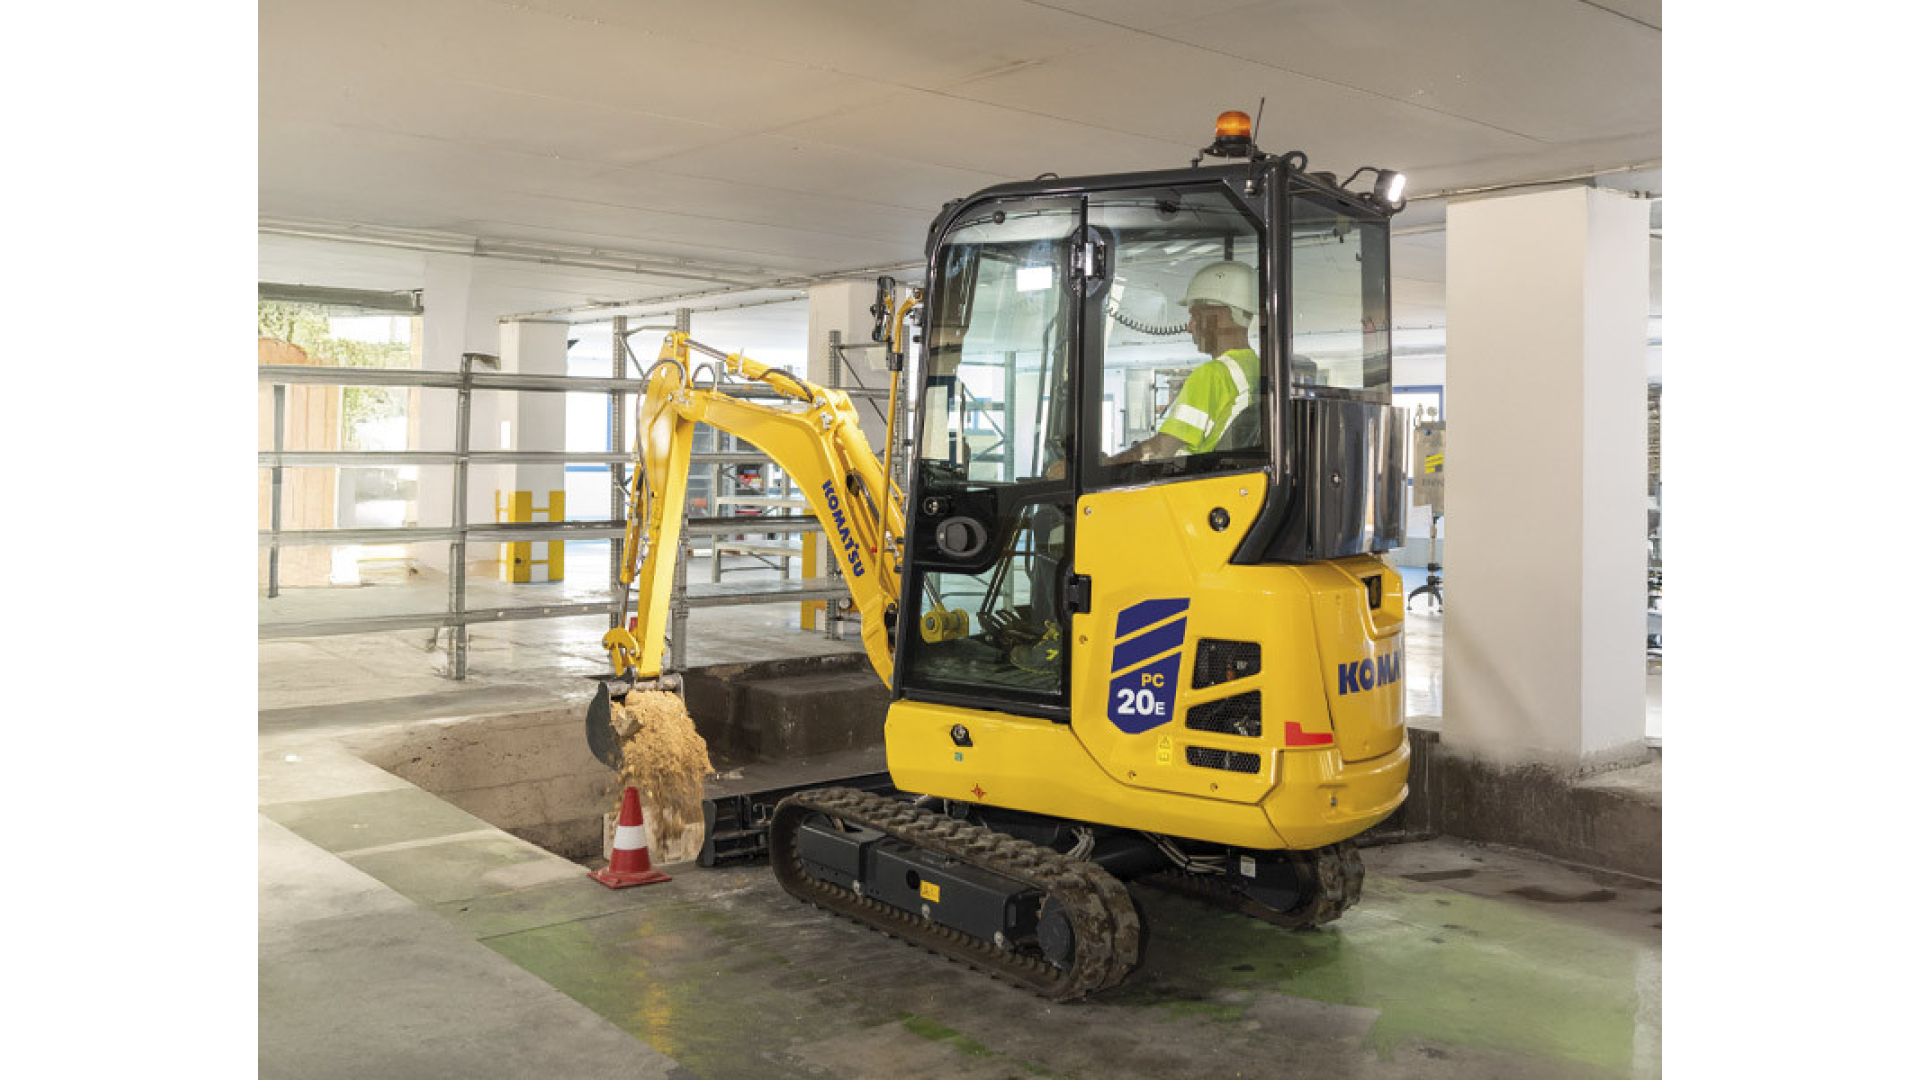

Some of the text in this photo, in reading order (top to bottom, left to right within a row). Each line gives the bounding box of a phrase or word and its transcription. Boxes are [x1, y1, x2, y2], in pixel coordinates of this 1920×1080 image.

[822, 479, 865, 577] KOMATSU
[1141, 673, 1165, 688] PC
[1338, 650, 1402, 695] KOMA
[1117, 688, 1166, 716] 20E
